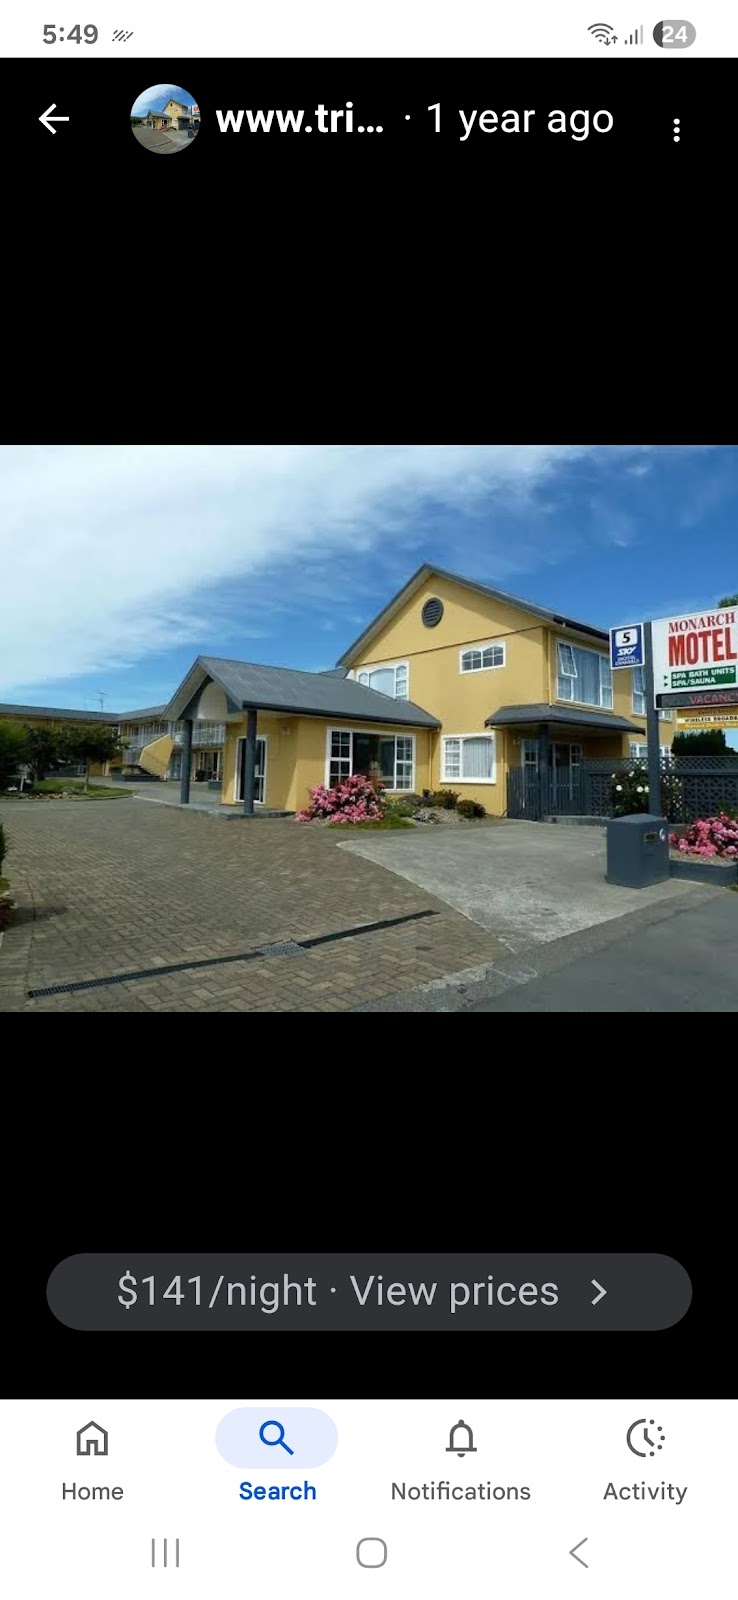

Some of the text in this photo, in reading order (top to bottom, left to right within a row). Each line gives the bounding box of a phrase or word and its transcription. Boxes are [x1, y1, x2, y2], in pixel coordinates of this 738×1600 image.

[668, 612, 735, 633] MONARCH
[622, 631, 631, 643] 5
[668, 627, 737, 667] MOTEL
[688, 670, 708, 678] BATH
[711, 667, 735, 675] UNITS
[672, 677, 716, 687] SPA/SAUNA
